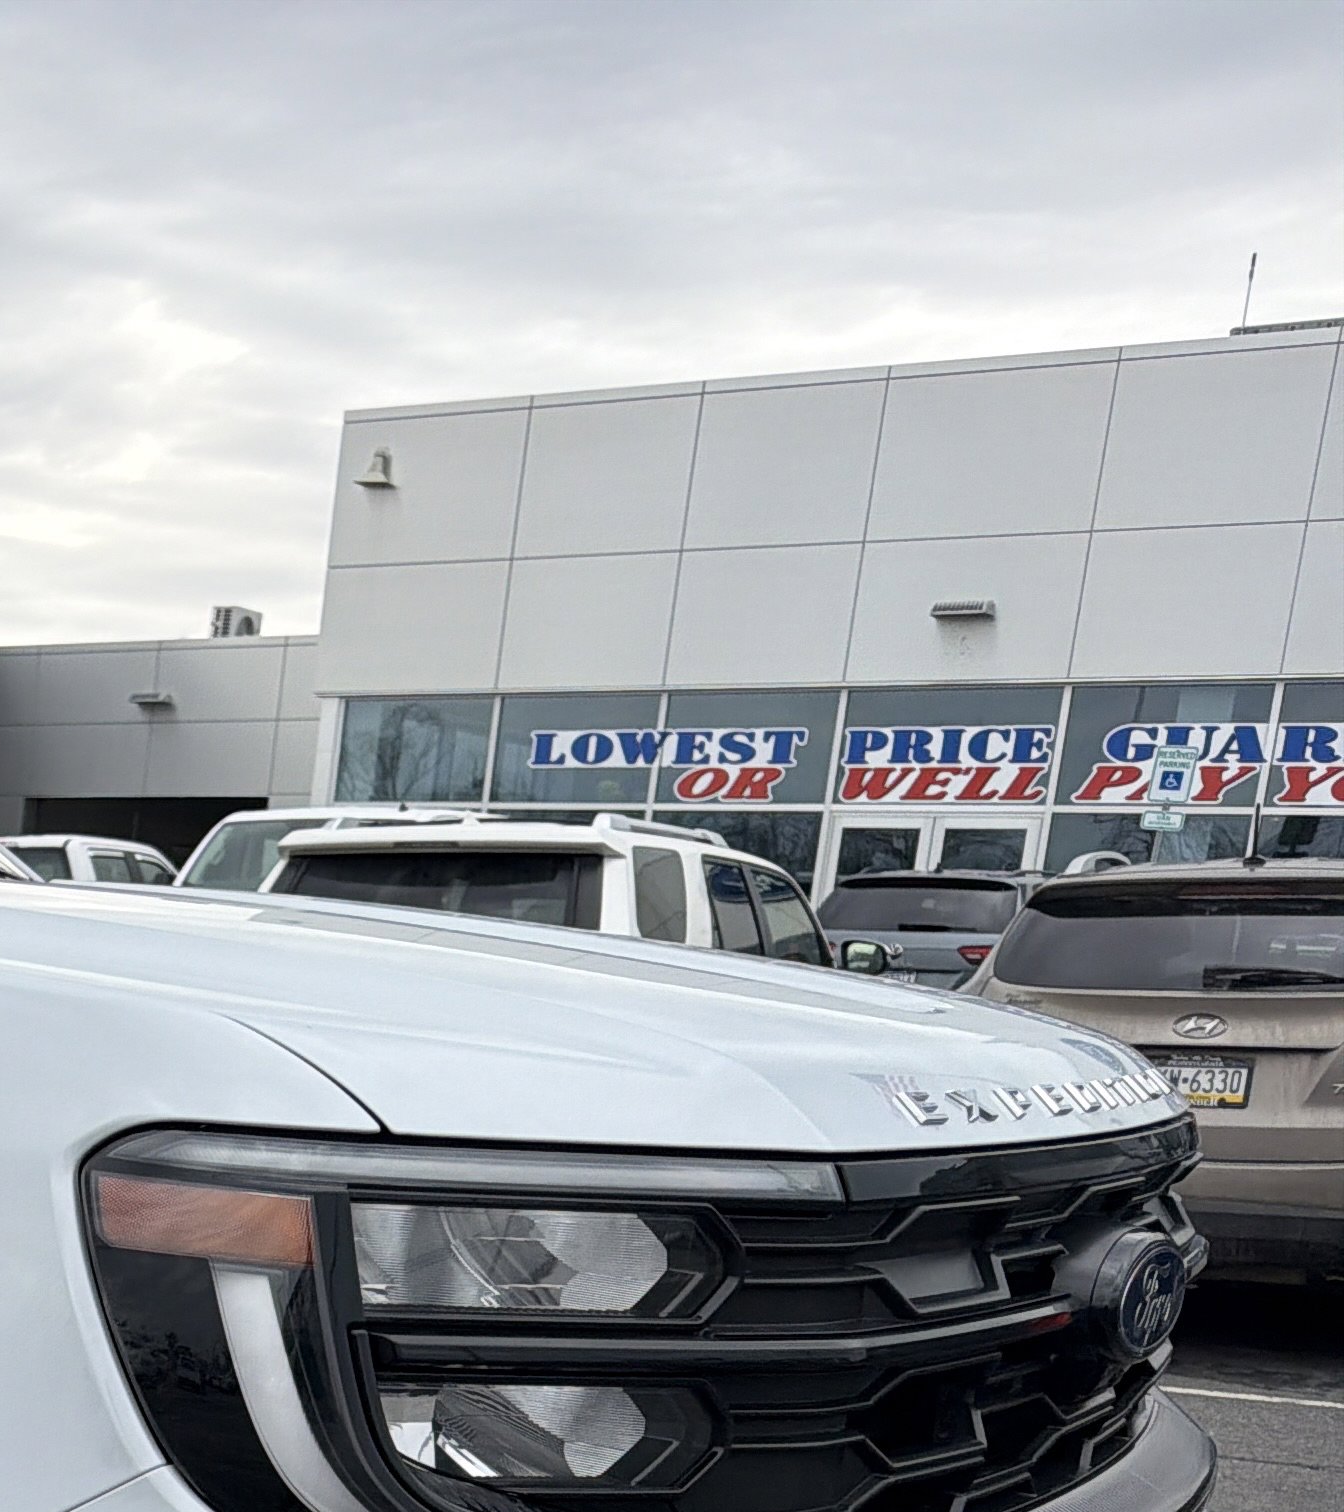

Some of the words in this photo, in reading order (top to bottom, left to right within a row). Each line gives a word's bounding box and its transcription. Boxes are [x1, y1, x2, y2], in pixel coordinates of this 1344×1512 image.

[531, 731, 806, 765] LOWEST
[844, 727, 1053, 765] PRICE
[1159, 760, 1191, 769] PARKING
[676, 767, 783, 800] OR
[842, 766, 1046, 801] WE'LL
[1074, 766, 1258, 802] PY
[1277, 766, 1344, 803] Y
